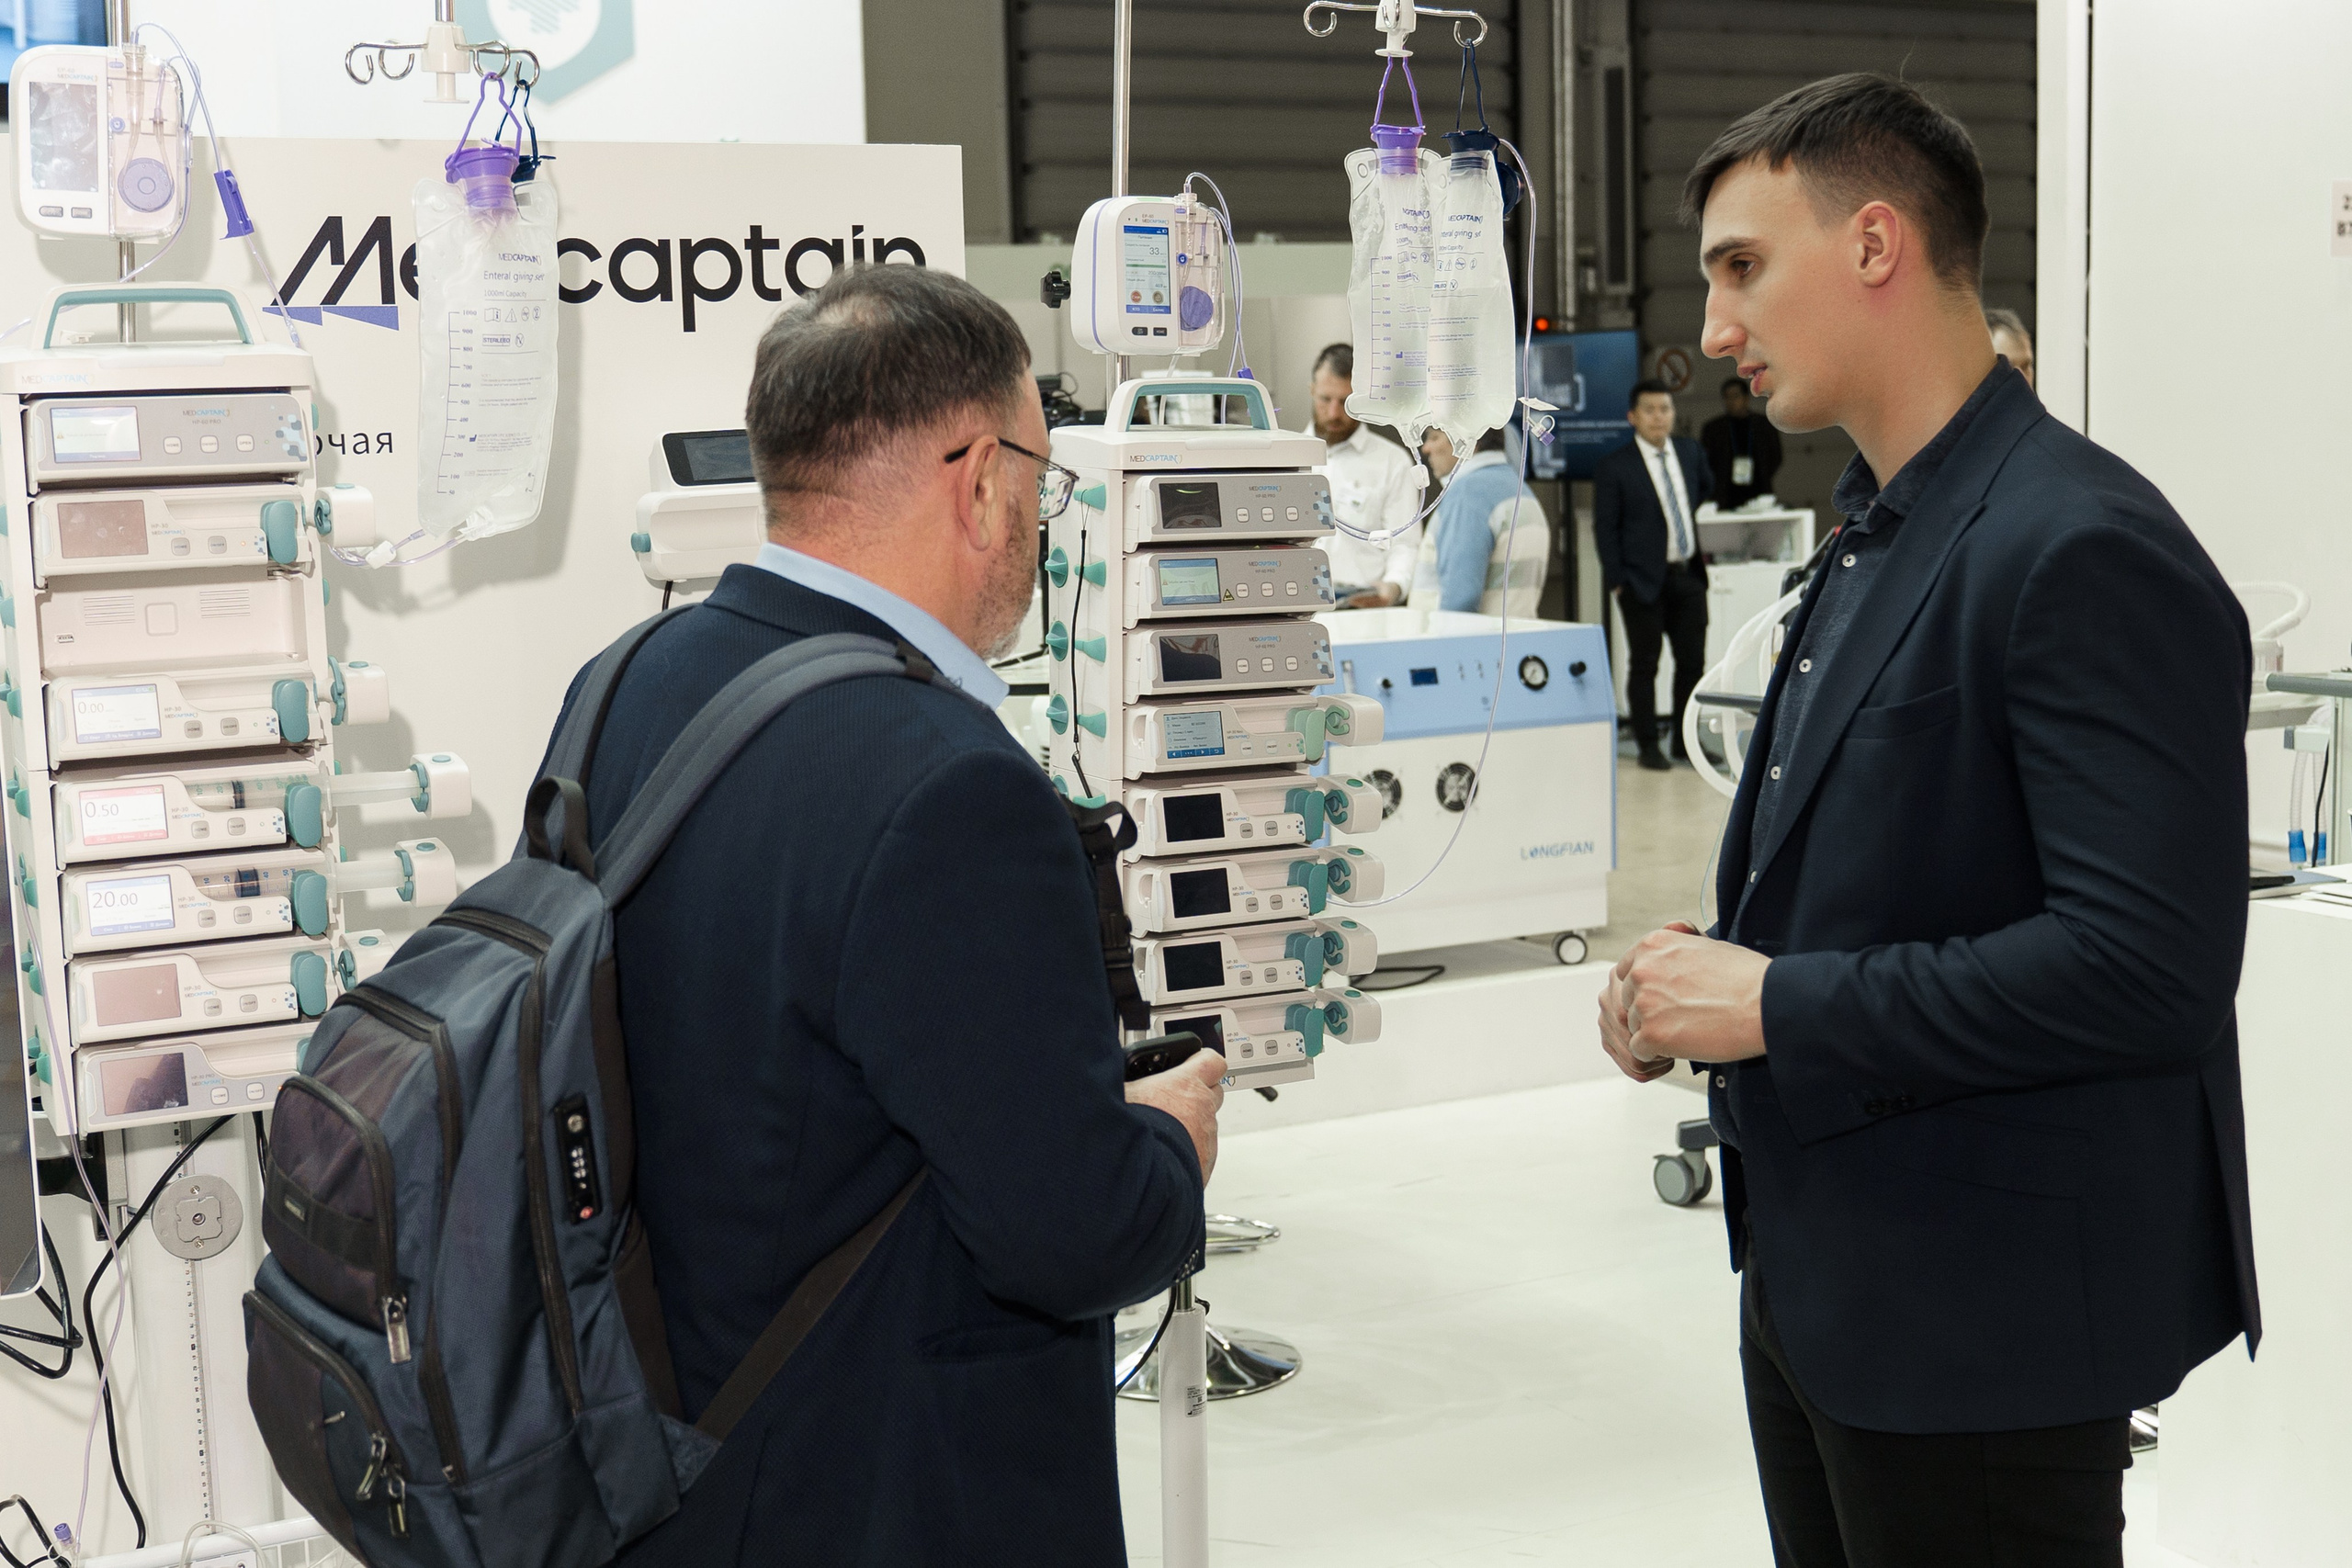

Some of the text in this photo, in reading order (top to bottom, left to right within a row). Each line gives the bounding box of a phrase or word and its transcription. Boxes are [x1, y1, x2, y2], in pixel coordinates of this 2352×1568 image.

[1149, 247, 1159, 255] 33
[483, 270, 511, 280] Enteral
[514, 271, 534, 283] giving
[22, 374, 95, 385] MEDCAPTAIN
[183, 409, 230, 417] MEDCAPTAIN
[1130, 454, 1182, 464] MEDCAPTAIN
[78, 701, 104, 714] 0.00
[85, 802, 119, 818] 0.50
[92, 891, 138, 909] 20.00
